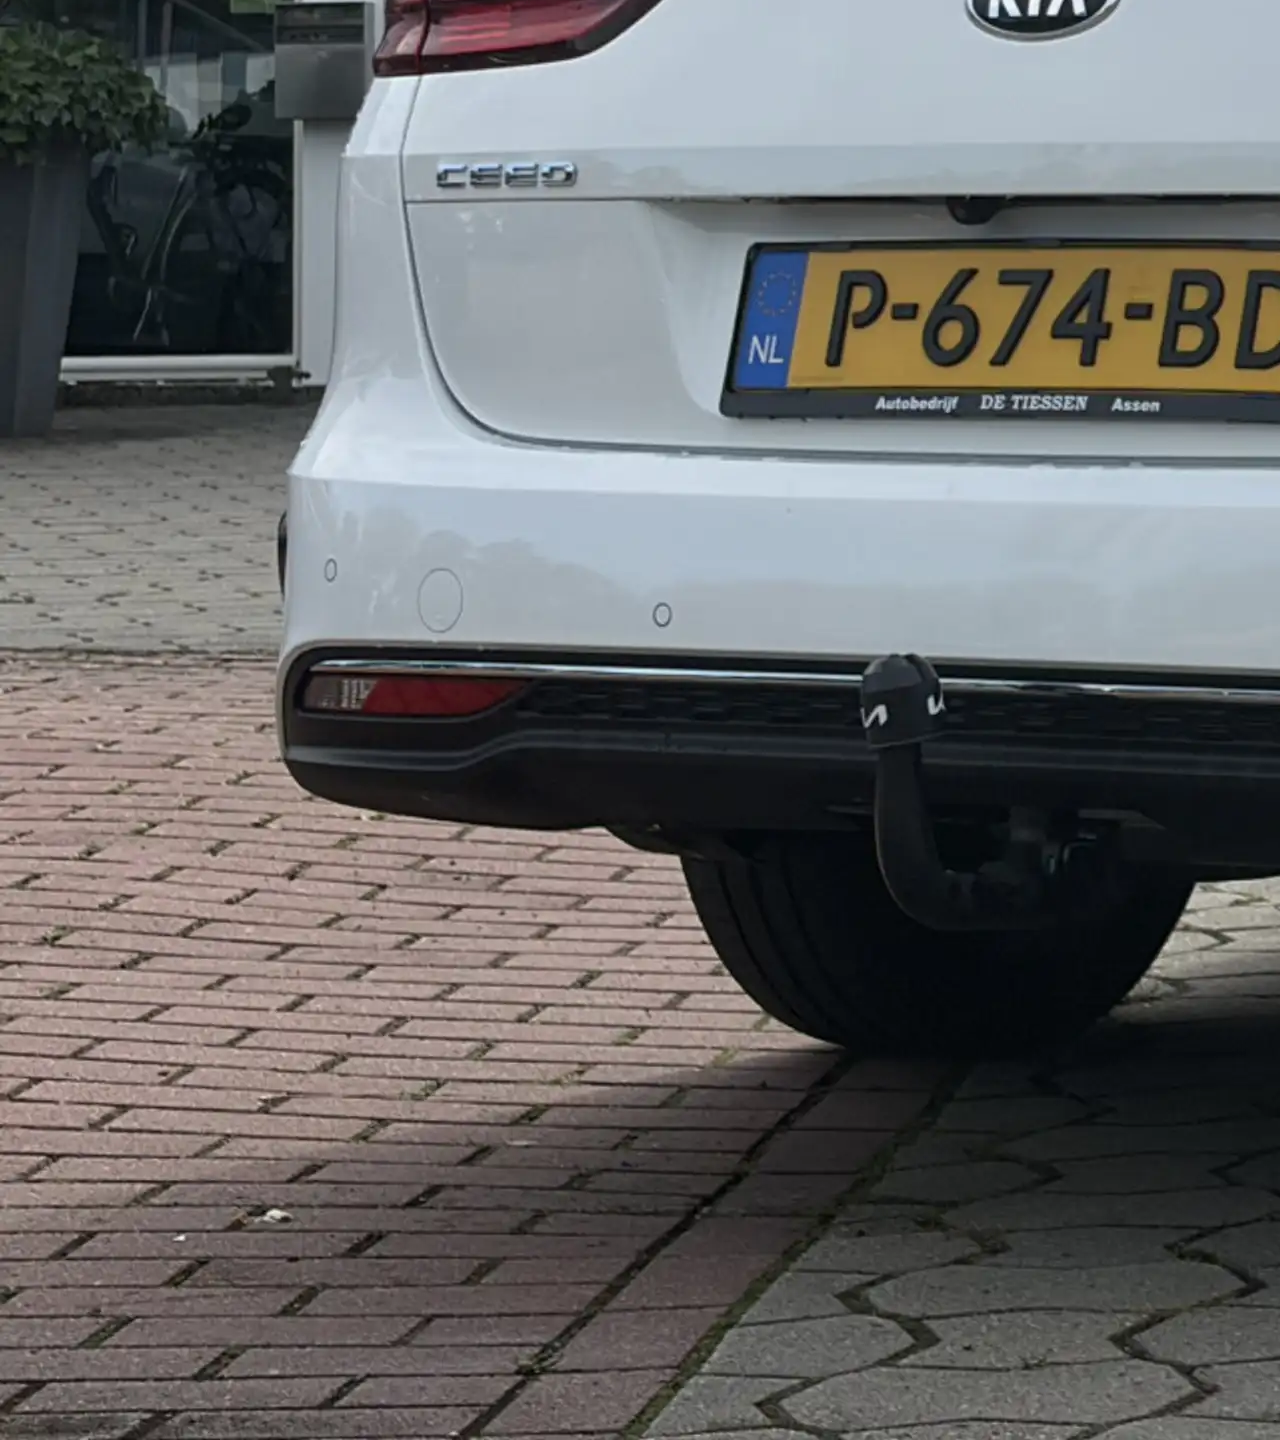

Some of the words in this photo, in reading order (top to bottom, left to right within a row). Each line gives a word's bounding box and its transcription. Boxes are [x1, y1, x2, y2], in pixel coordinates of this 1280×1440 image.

[436, 162, 579, 188] CEED
[747, 334, 785, 365] NL
[875, 395, 960, 413] Autobedrijf
[980, 393, 1006, 411] DE
[1009, 394, 1090, 412] TIESSEN
[1111, 397, 1161, 413] Assen
